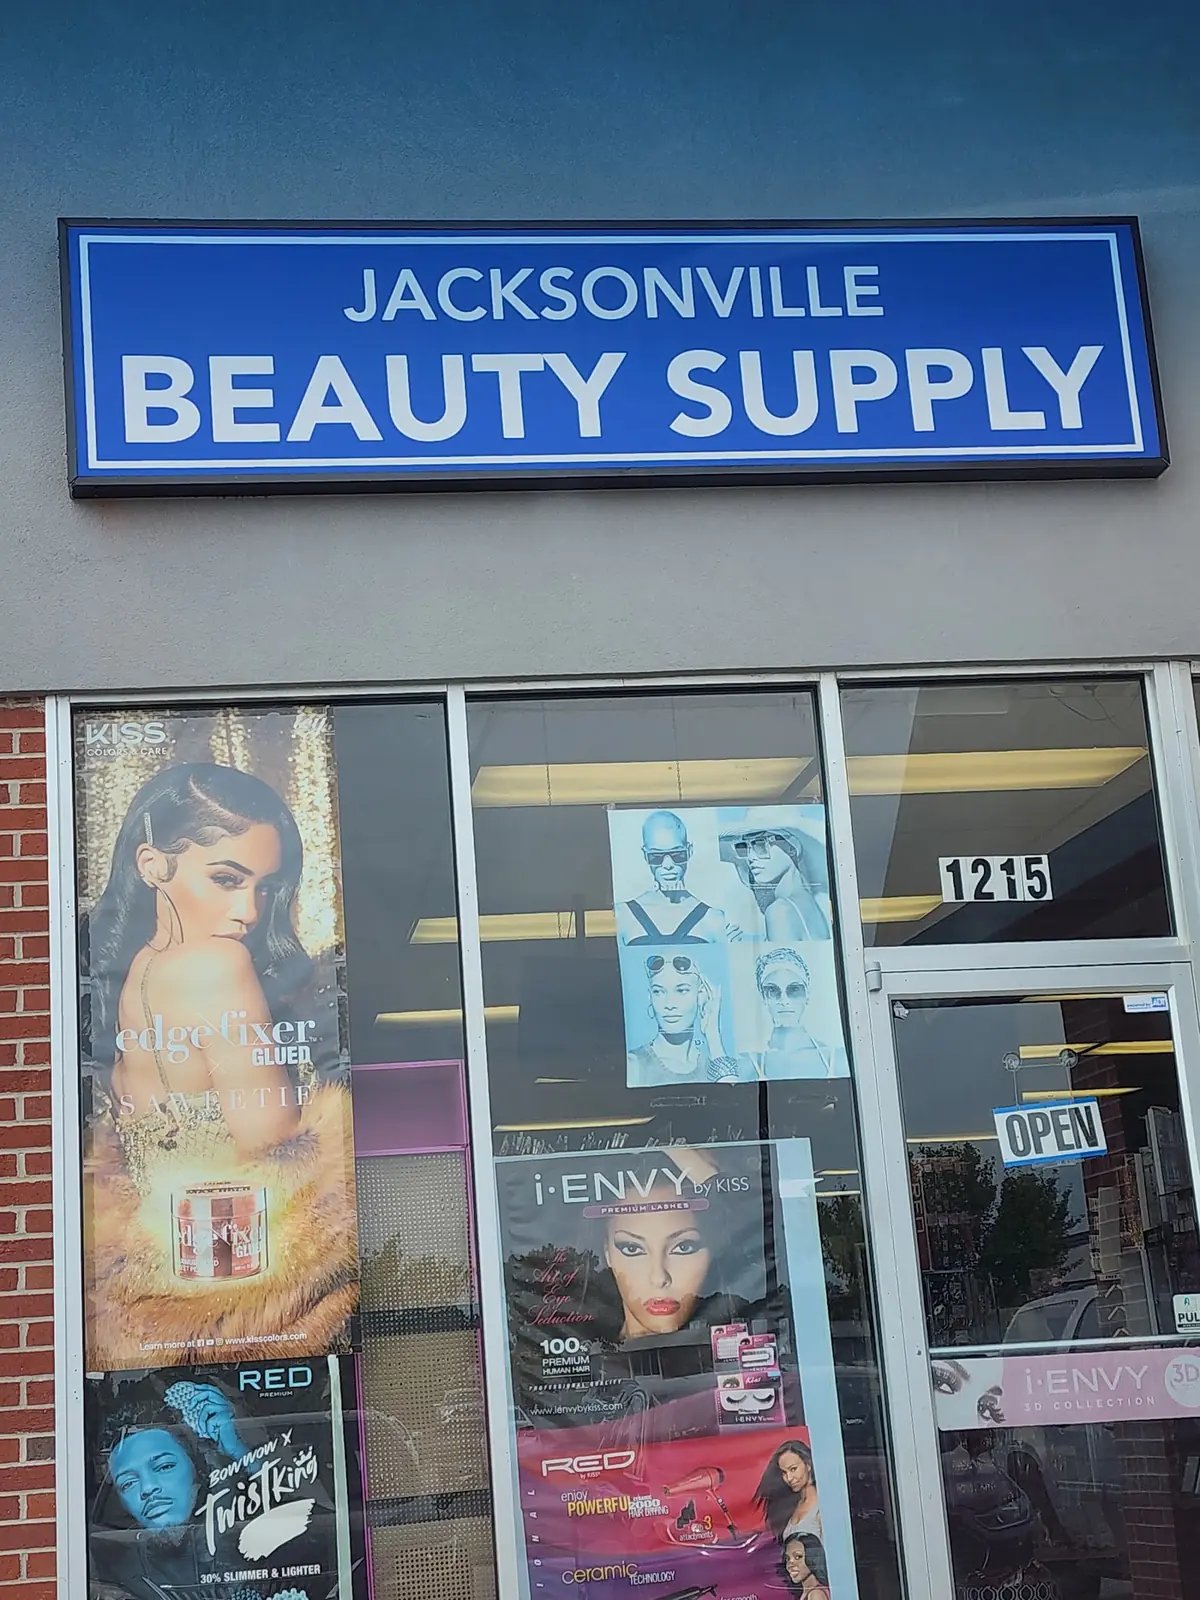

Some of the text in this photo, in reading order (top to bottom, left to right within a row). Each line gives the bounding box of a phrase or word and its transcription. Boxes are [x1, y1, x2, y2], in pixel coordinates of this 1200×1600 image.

[343, 265, 885, 323] JACKSONVILLE
[122, 345, 1105, 444] BEAUTY SUPPLY
[86, 722, 167, 745] KISS
[87, 747, 128, 757] COLORS
[140, 746, 167, 755] CARE
[946, 858, 1048, 900] 1215
[115, 1010, 316, 1064] edge fixer
[252, 1046, 311, 1066] GLUED
[119, 1084, 314, 1116] SAWEETIE
[1005, 1104, 1099, 1158] OPEN
[693, 1181, 712, 1197] by
[715, 1176, 750, 1193] KISS
[601, 1202, 690, 1214] PREMIUM LASHES
[563, 1263, 585, 1288] of
[524, 1304, 595, 1326] Seduction
[139, 1332, 308, 1351] Learn more at www.kisscolors.com
[540, 1337, 588, 1355] 100%
[542, 1355, 590, 1367] PREMIUM
[542, 1365, 591, 1376] HUMAN HAIR
[239, 1366, 313, 1391] RED
[1172, 1363, 1200, 1383] 3D
[589, 1379, 622, 1388] QUALITY
[259, 1390, 294, 1398] PREMIUM
[1024, 1396, 1155, 1412] 3D COLLECTION
[530, 1402, 624, 1416] www.ienvybykiss.com
[541, 1450, 636, 1477] RED
[560, 1490, 588, 1502] enjoy
[629, 1498, 661, 1509] 2000
[704, 1515, 712, 1530] 3
[200, 1564, 321, 1584] 30% SLIMMER & LIGHTER
[561, 1560, 639, 1585] ceramic
[629, 1570, 676, 1586] TECHNOLOGY
